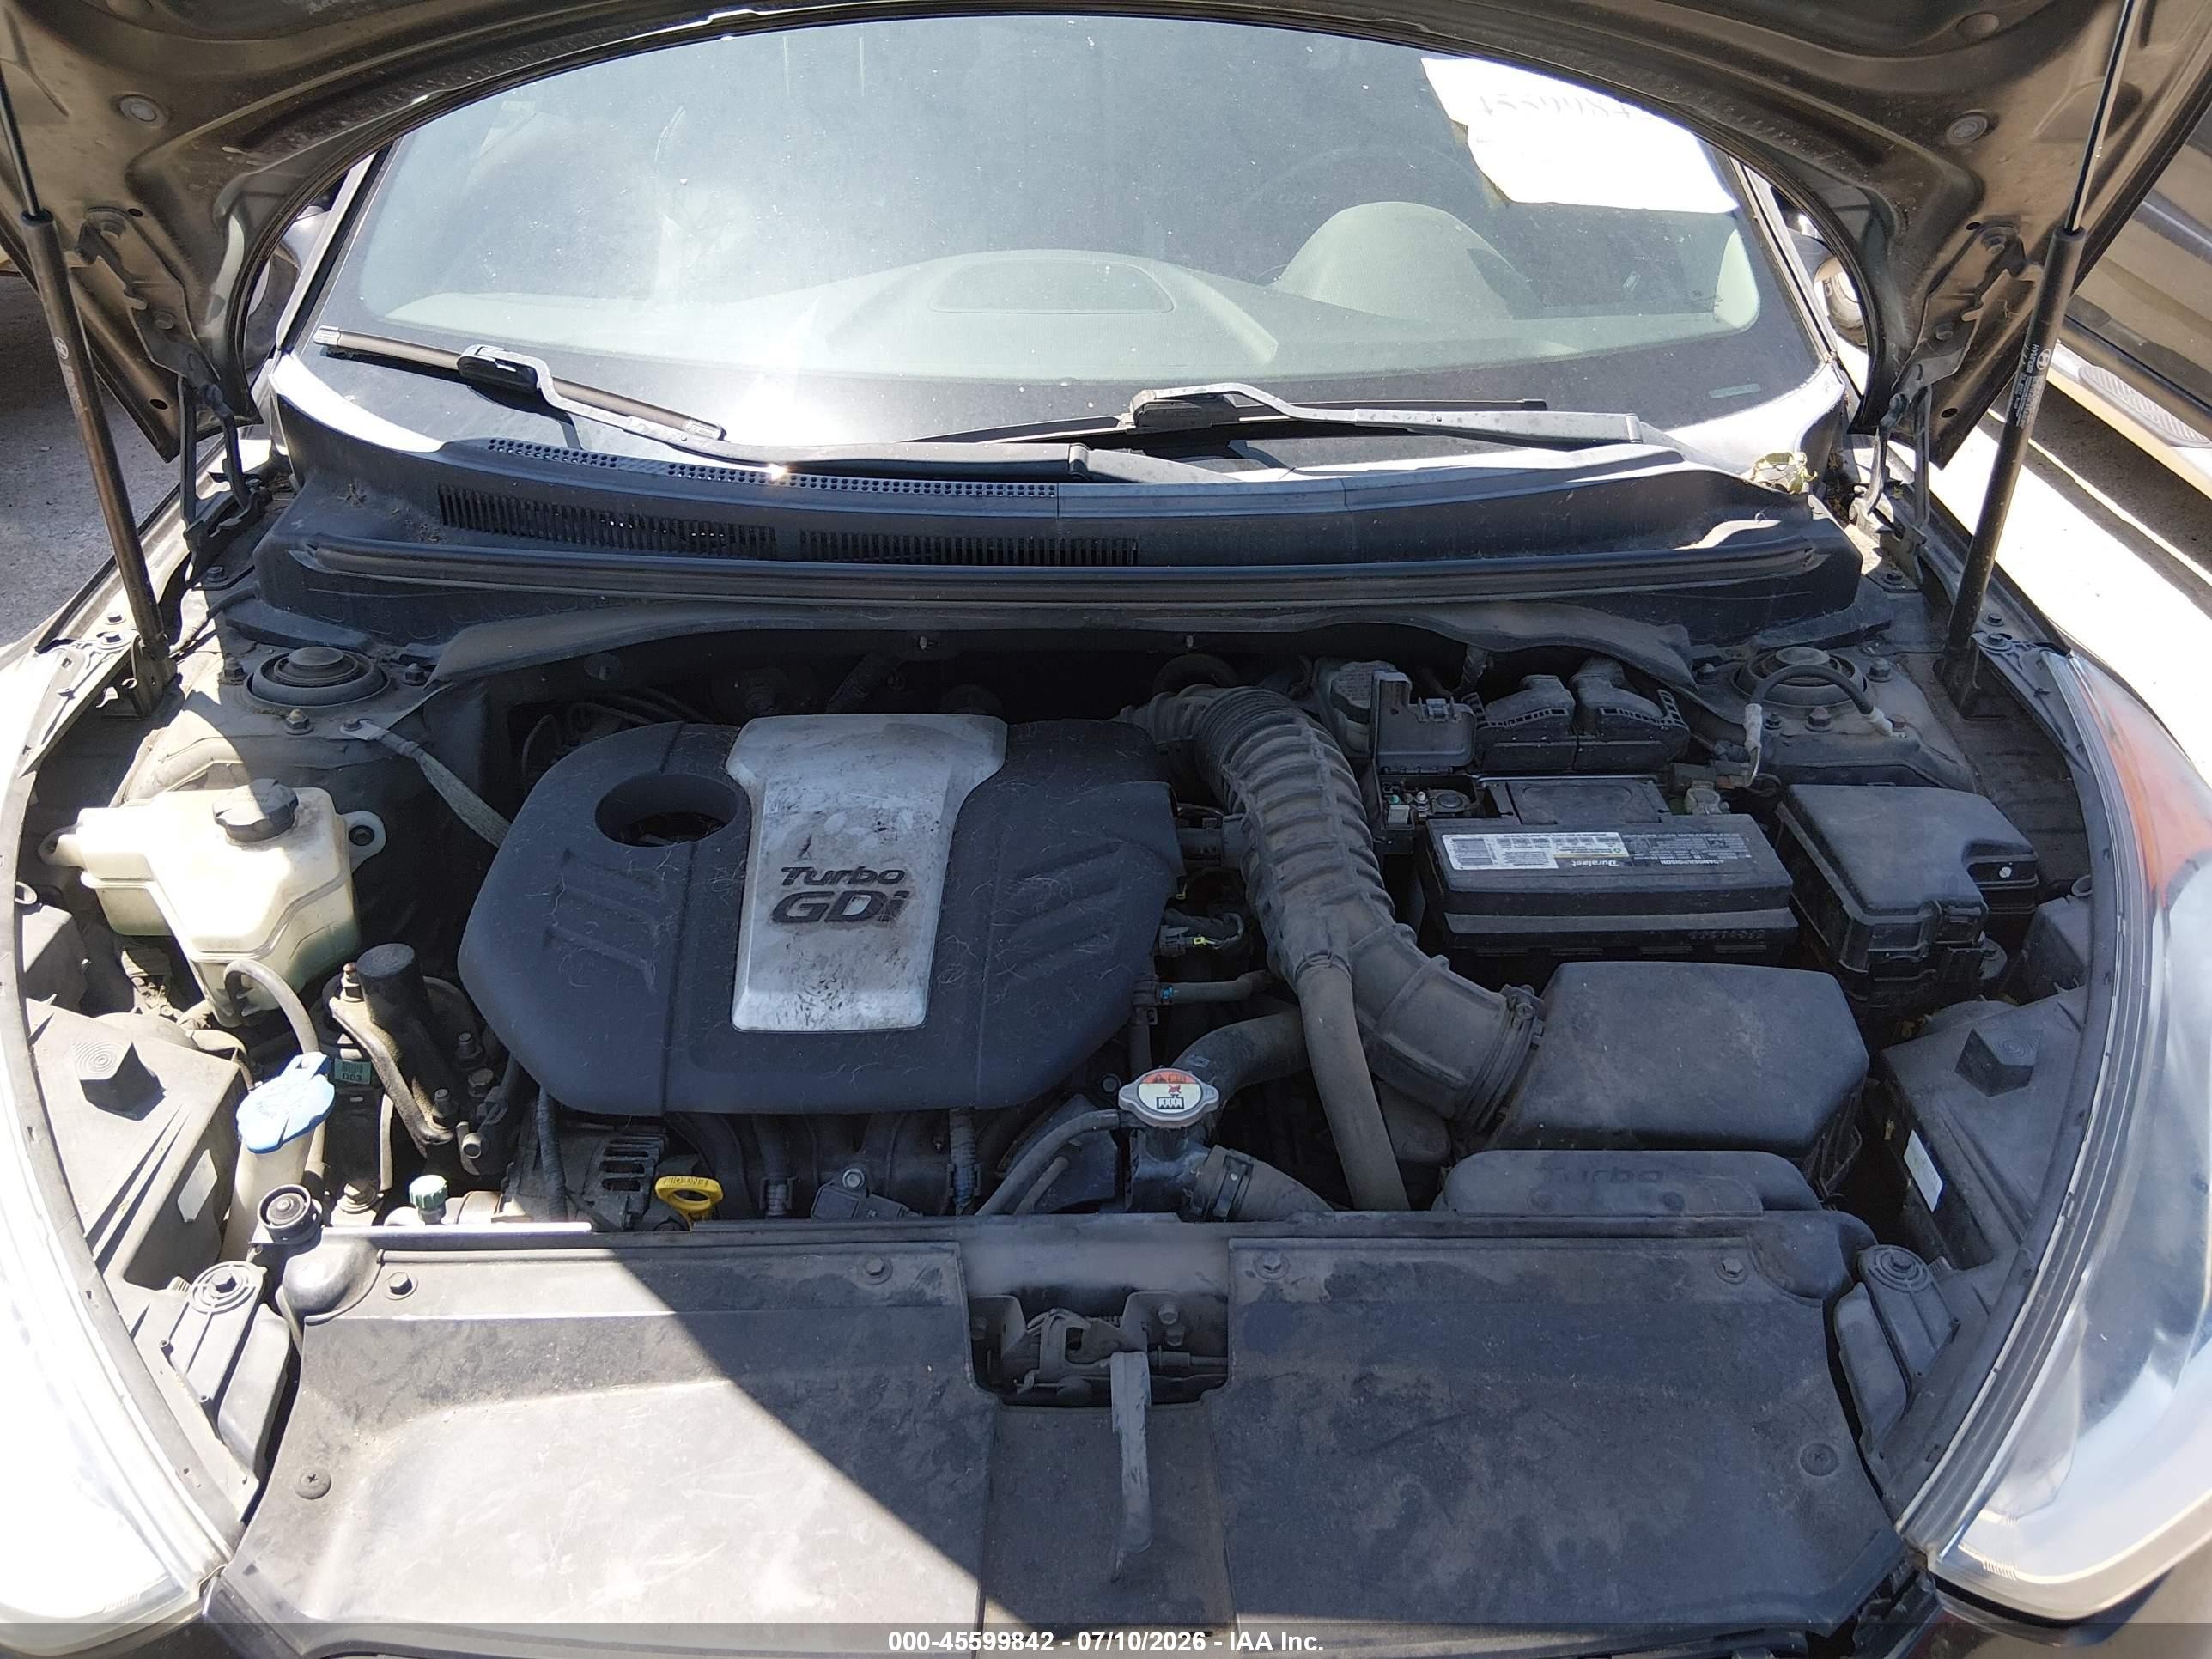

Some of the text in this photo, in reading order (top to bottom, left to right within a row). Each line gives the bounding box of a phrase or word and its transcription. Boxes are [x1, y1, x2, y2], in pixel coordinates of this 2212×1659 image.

[781, 866, 906, 886] Turbo
[771, 890, 910, 923] GDi
[1536, 1165, 1665, 1183] Turbo
